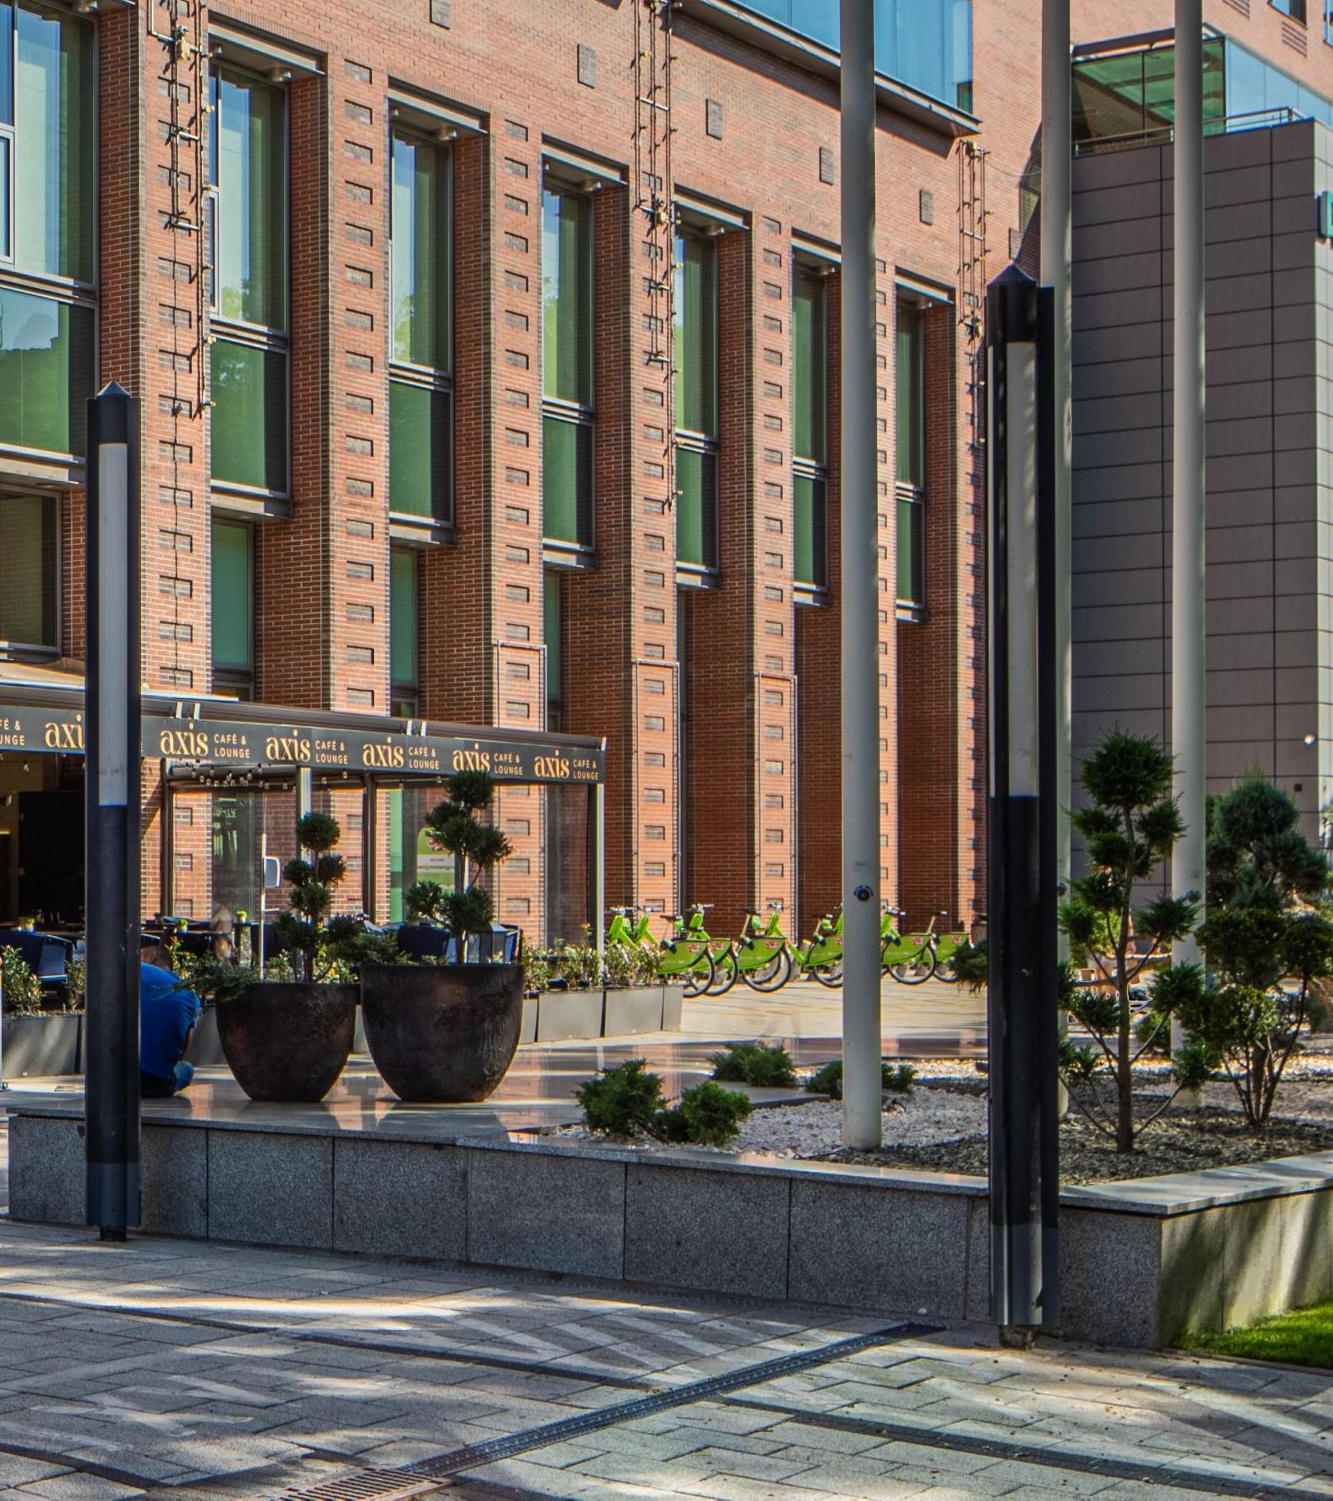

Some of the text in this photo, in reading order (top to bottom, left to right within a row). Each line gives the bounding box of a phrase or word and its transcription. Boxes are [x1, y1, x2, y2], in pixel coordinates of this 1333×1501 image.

[15, 720, 22, 731] &
[45, 714, 85, 749] axi
[160, 723, 209, 756] axis
[214, 733, 247, 745] CAFÉ &
[266, 729, 311, 762] axis
[315, 739, 336, 751] CAFÉ
[214, 748, 250, 759] LOUNGE
[362, 736, 404, 768] axis
[408, 746, 428, 756] CAFÉ
[316, 754, 348, 764] LOUNGE
[453, 743, 490, 772] axis
[494, 752, 513, 763] CAFÉ
[409, 759, 440, 770] LOUNGE
[534, 749, 569, 778] axis
[494, 765, 523, 776] LOUNGE
[573, 771, 599, 781] LOUNGE
